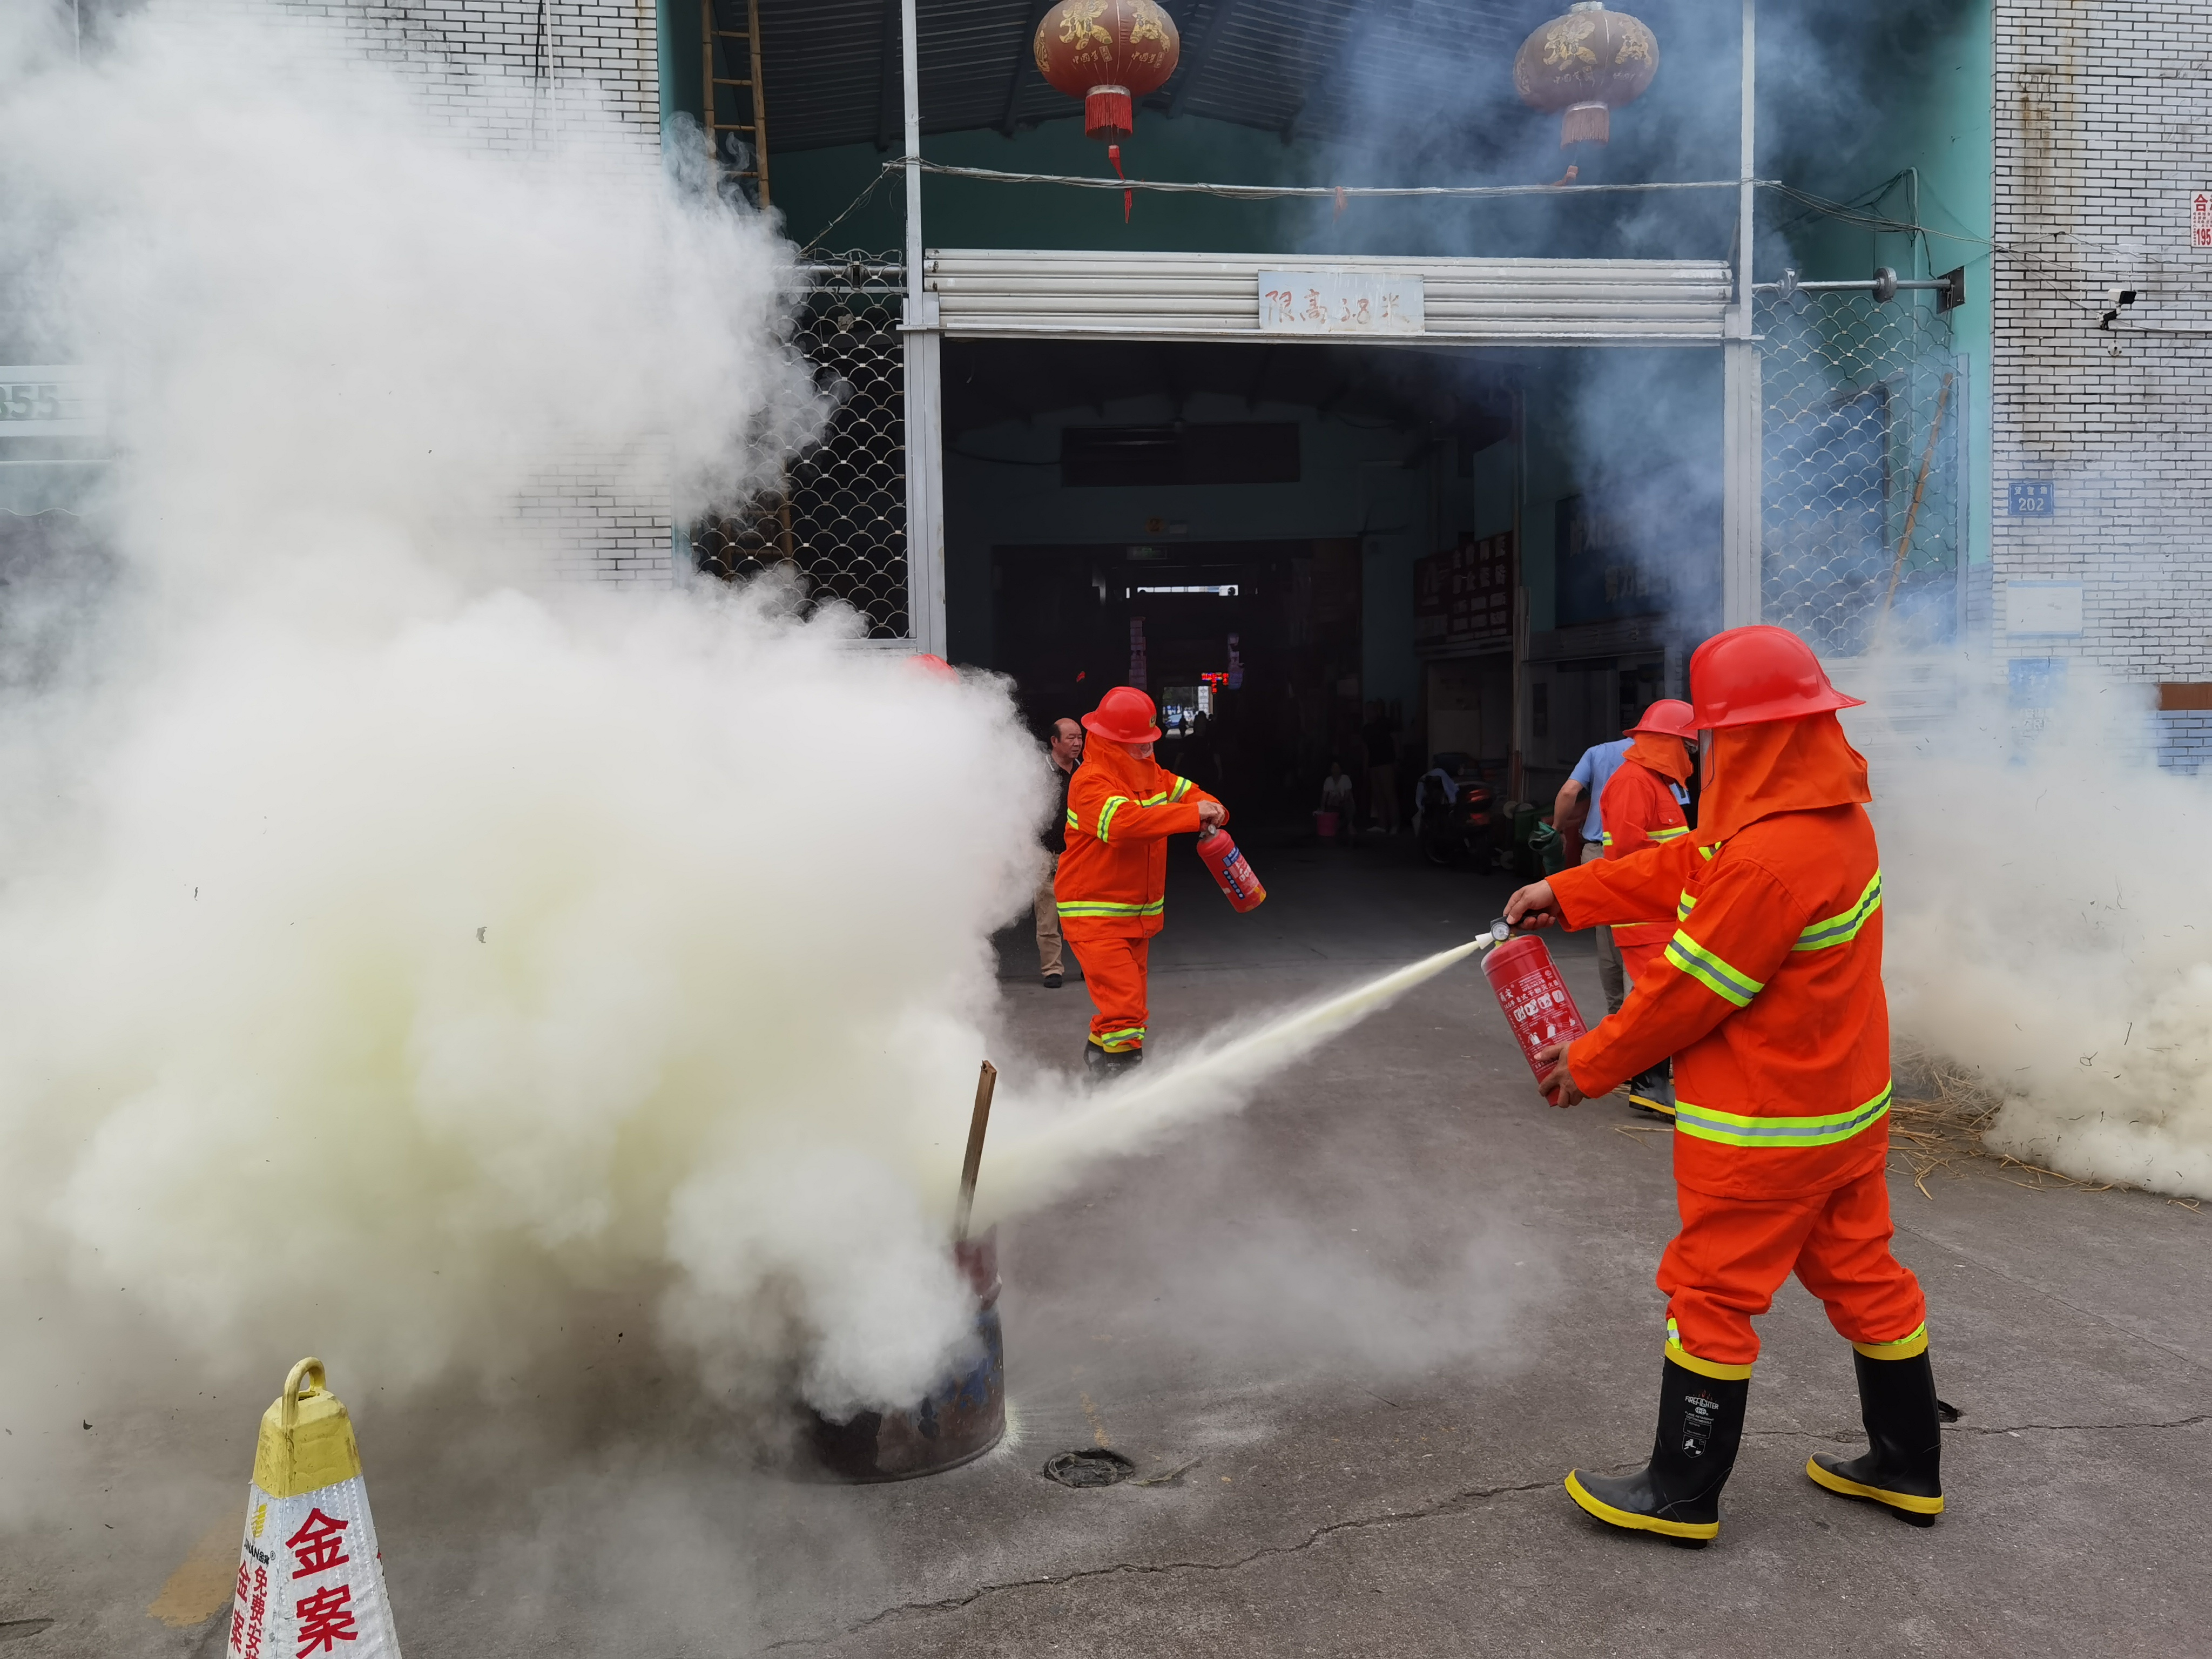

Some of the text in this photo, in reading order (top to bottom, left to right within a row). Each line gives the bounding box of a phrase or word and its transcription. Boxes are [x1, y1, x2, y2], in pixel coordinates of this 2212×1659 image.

[2196, 228, 2211, 246] 195
[2019, 497, 2044, 511] 202
[1685, 1396, 1719, 1410] FIREFIGHTER
